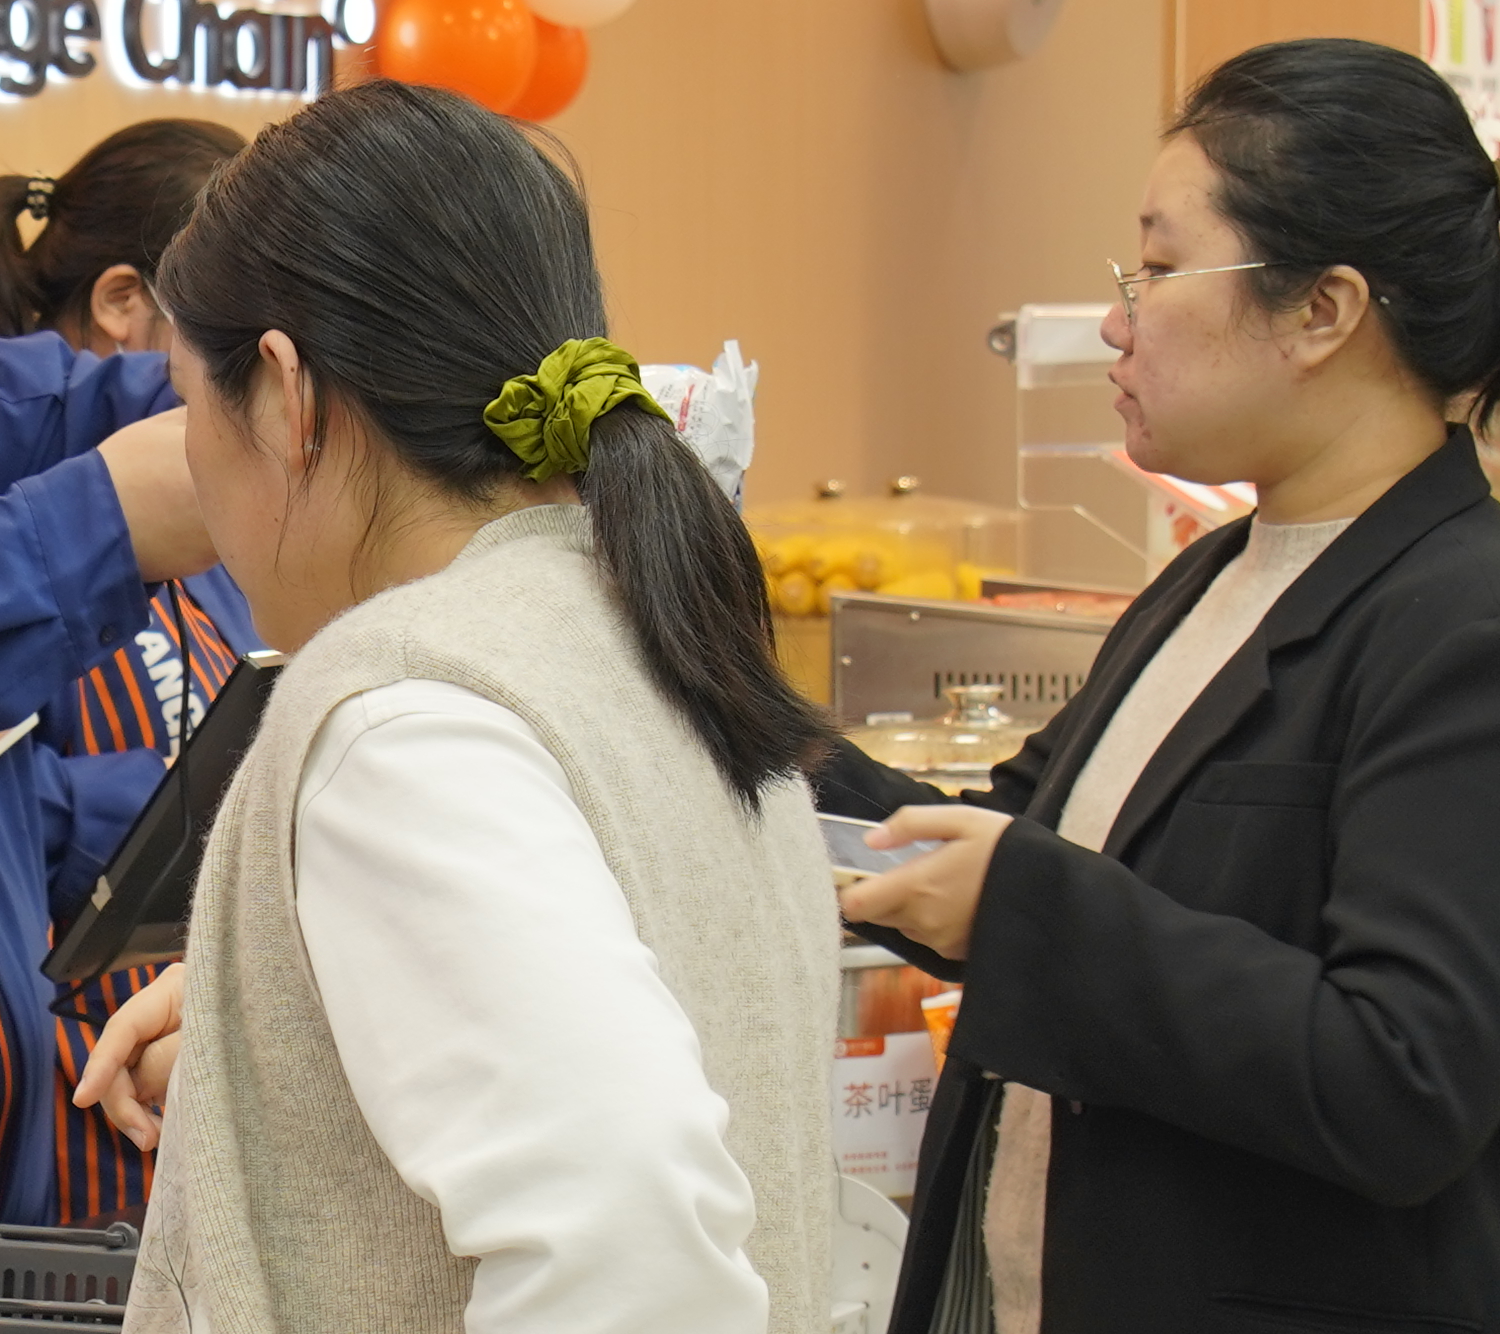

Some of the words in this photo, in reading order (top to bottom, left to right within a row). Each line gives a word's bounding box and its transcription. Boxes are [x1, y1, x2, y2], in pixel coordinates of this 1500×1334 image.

[134, 610, 206, 770] ANG
[843, 1077, 932, 1119] 茶叶蛋
